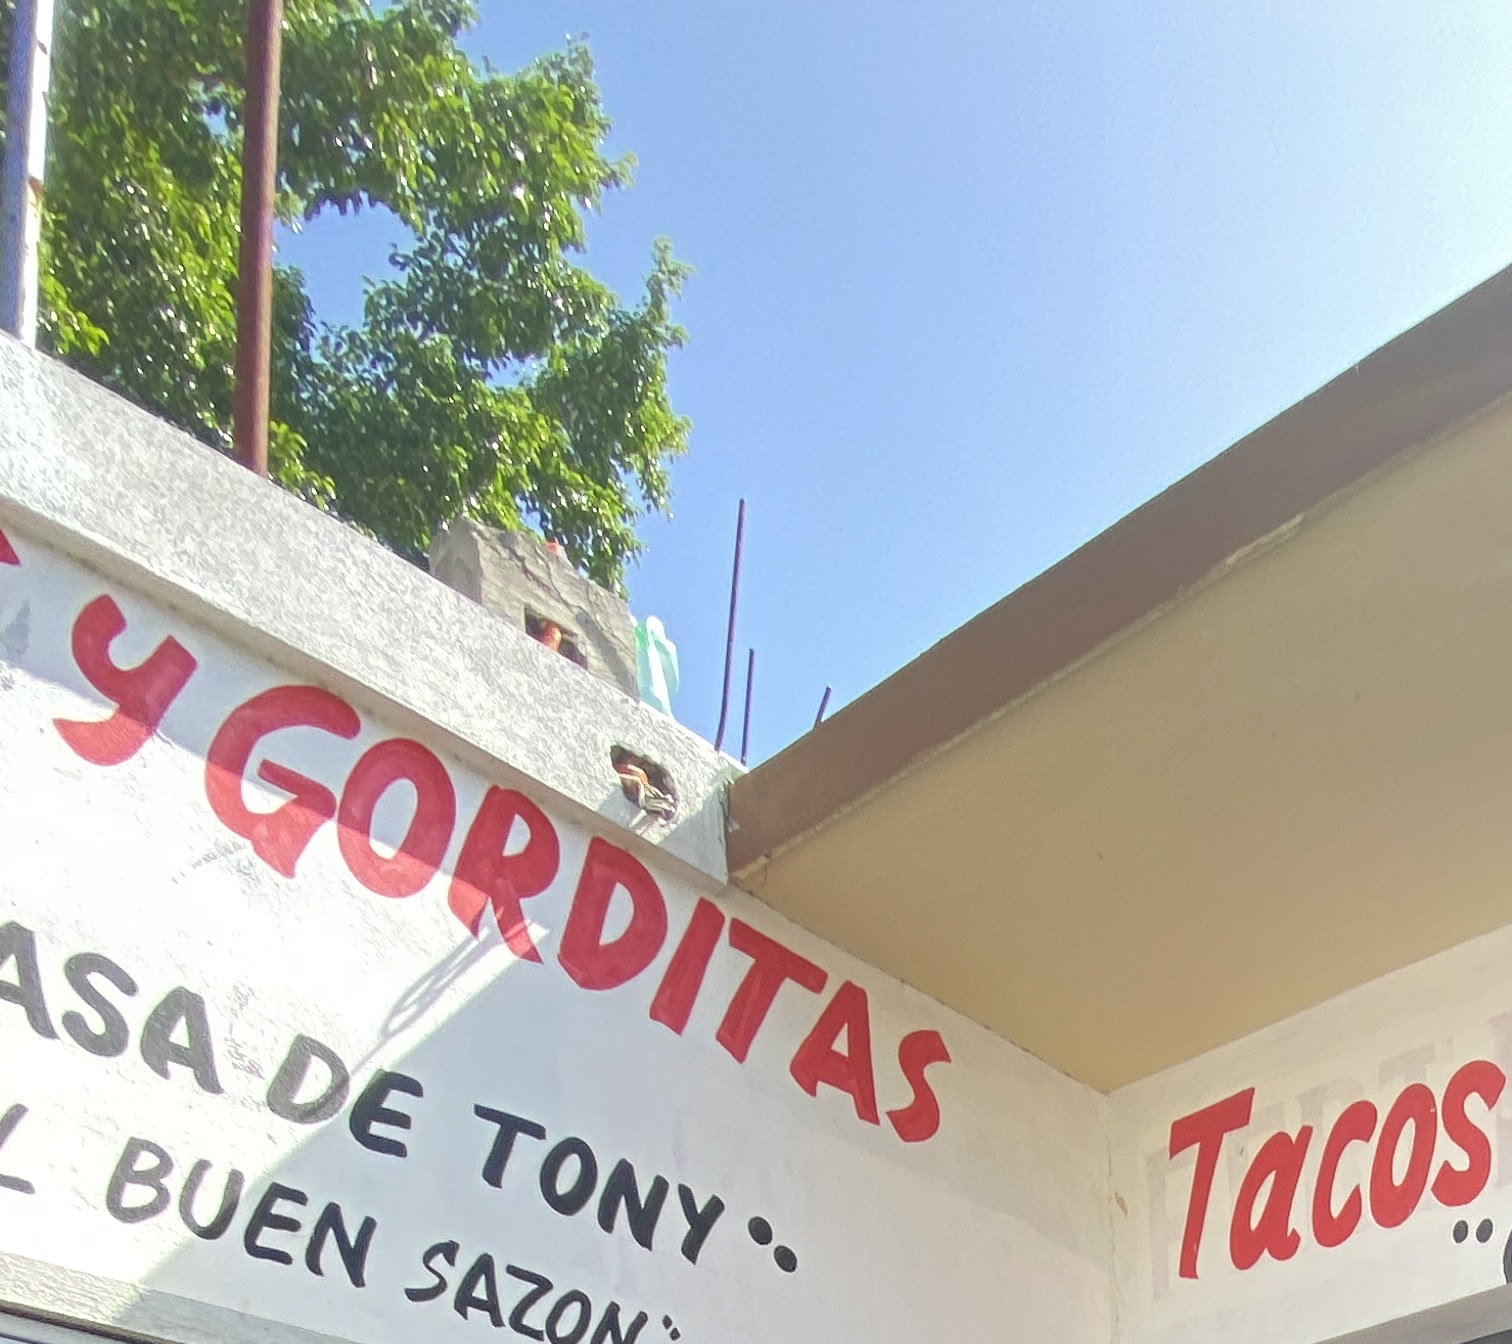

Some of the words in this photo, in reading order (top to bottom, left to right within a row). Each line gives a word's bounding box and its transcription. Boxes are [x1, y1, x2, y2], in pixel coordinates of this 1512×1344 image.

[204, 684, 952, 1144] GORDITAS
[266, 1034, 424, 1159] DE
[1168, 1060, 1508, 1281] Tacos
[105, 1136, 377, 1288] BUEN
